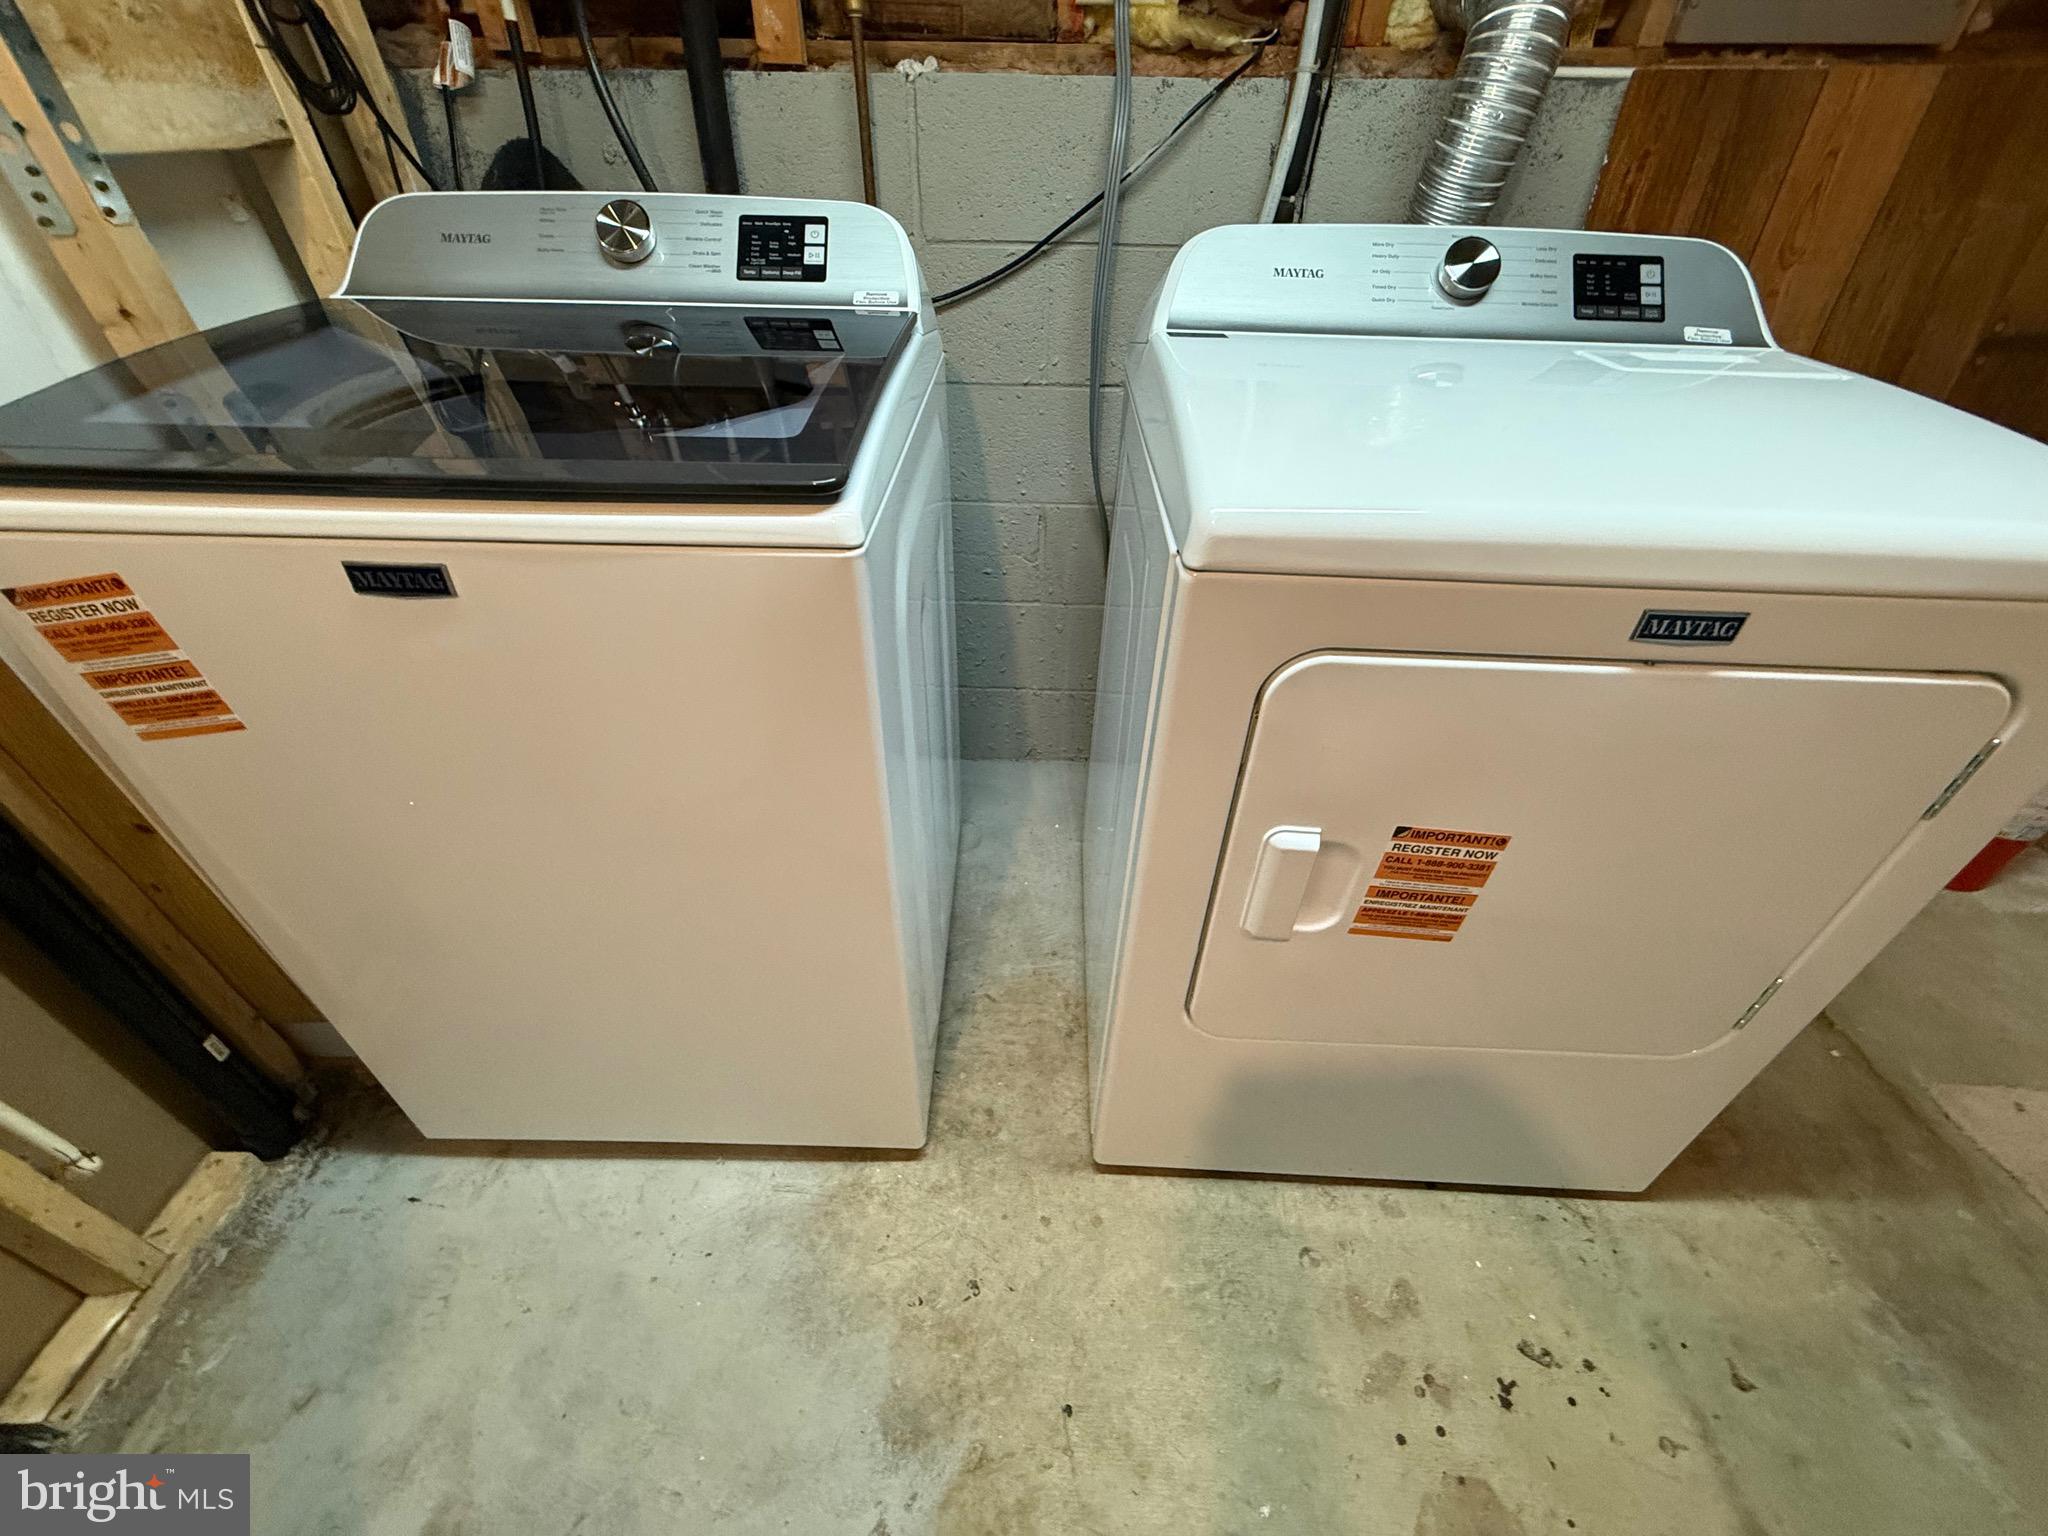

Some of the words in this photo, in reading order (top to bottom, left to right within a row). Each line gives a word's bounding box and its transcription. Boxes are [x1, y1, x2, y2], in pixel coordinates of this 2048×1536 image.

[440, 232, 491, 244] MAYTAG
[1272, 267, 1325, 279] MAYTAG
[351, 570, 445, 590] MAYTAG
[22, 579, 112, 603] IMPORTANT!
[26, 603, 103, 624] REGISTER
[101, 597, 140, 615] NOW
[1643, 619, 1739, 637] MAYTAG
[1410, 828, 1495, 847] IMPORTANT!
[1385, 855, 1413, 866] CALL
[1391, 842, 1462, 858] REGISTER
[1463, 849, 1500, 861] NOW
[1376, 889, 1467, 906] IMPORTANTE!
[1420, 904, 1470, 914] MAINTENANT
